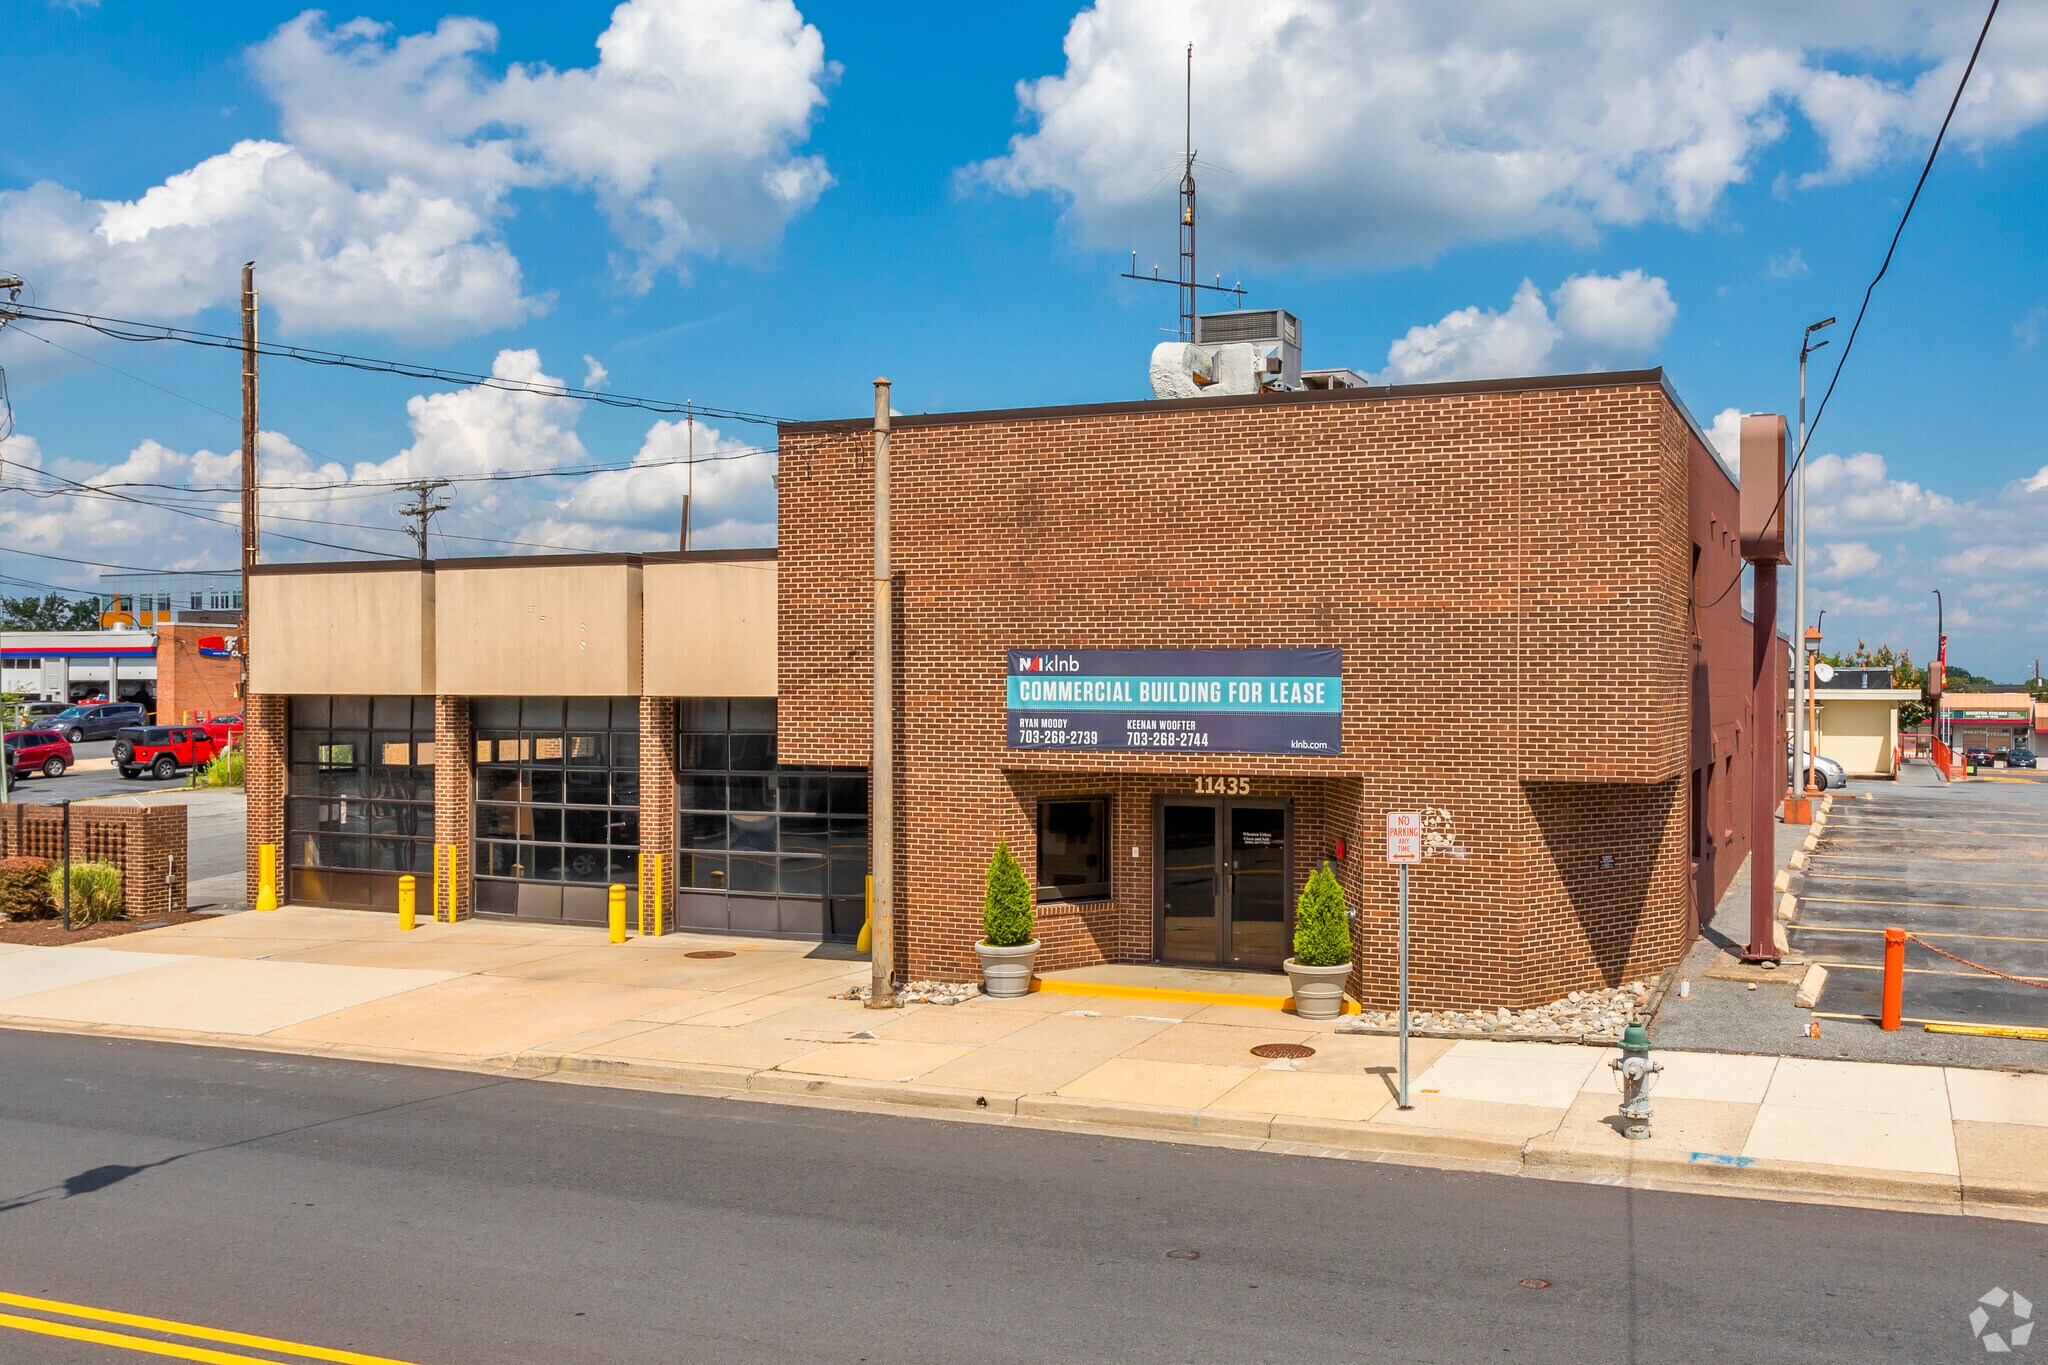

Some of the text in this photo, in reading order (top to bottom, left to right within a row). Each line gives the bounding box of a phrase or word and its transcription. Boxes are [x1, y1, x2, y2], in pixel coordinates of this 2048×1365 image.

[1020, 681, 1326, 704] COMMERCIAL BUILDING FOR LEASE
[1019, 718, 1068, 729] RYAN MOODY
[1127, 720, 1196, 731] KEENAN WOOFTER
[1019, 730, 1098, 745] 703-268-2739
[1127, 731, 1209, 747] 703-268-2744
[1291, 739, 1328, 750] klnb.com
[1194, 776, 1250, 795] 11435
[1397, 816, 1410, 826] NO
[1389, 827, 1419, 837] PARKING
